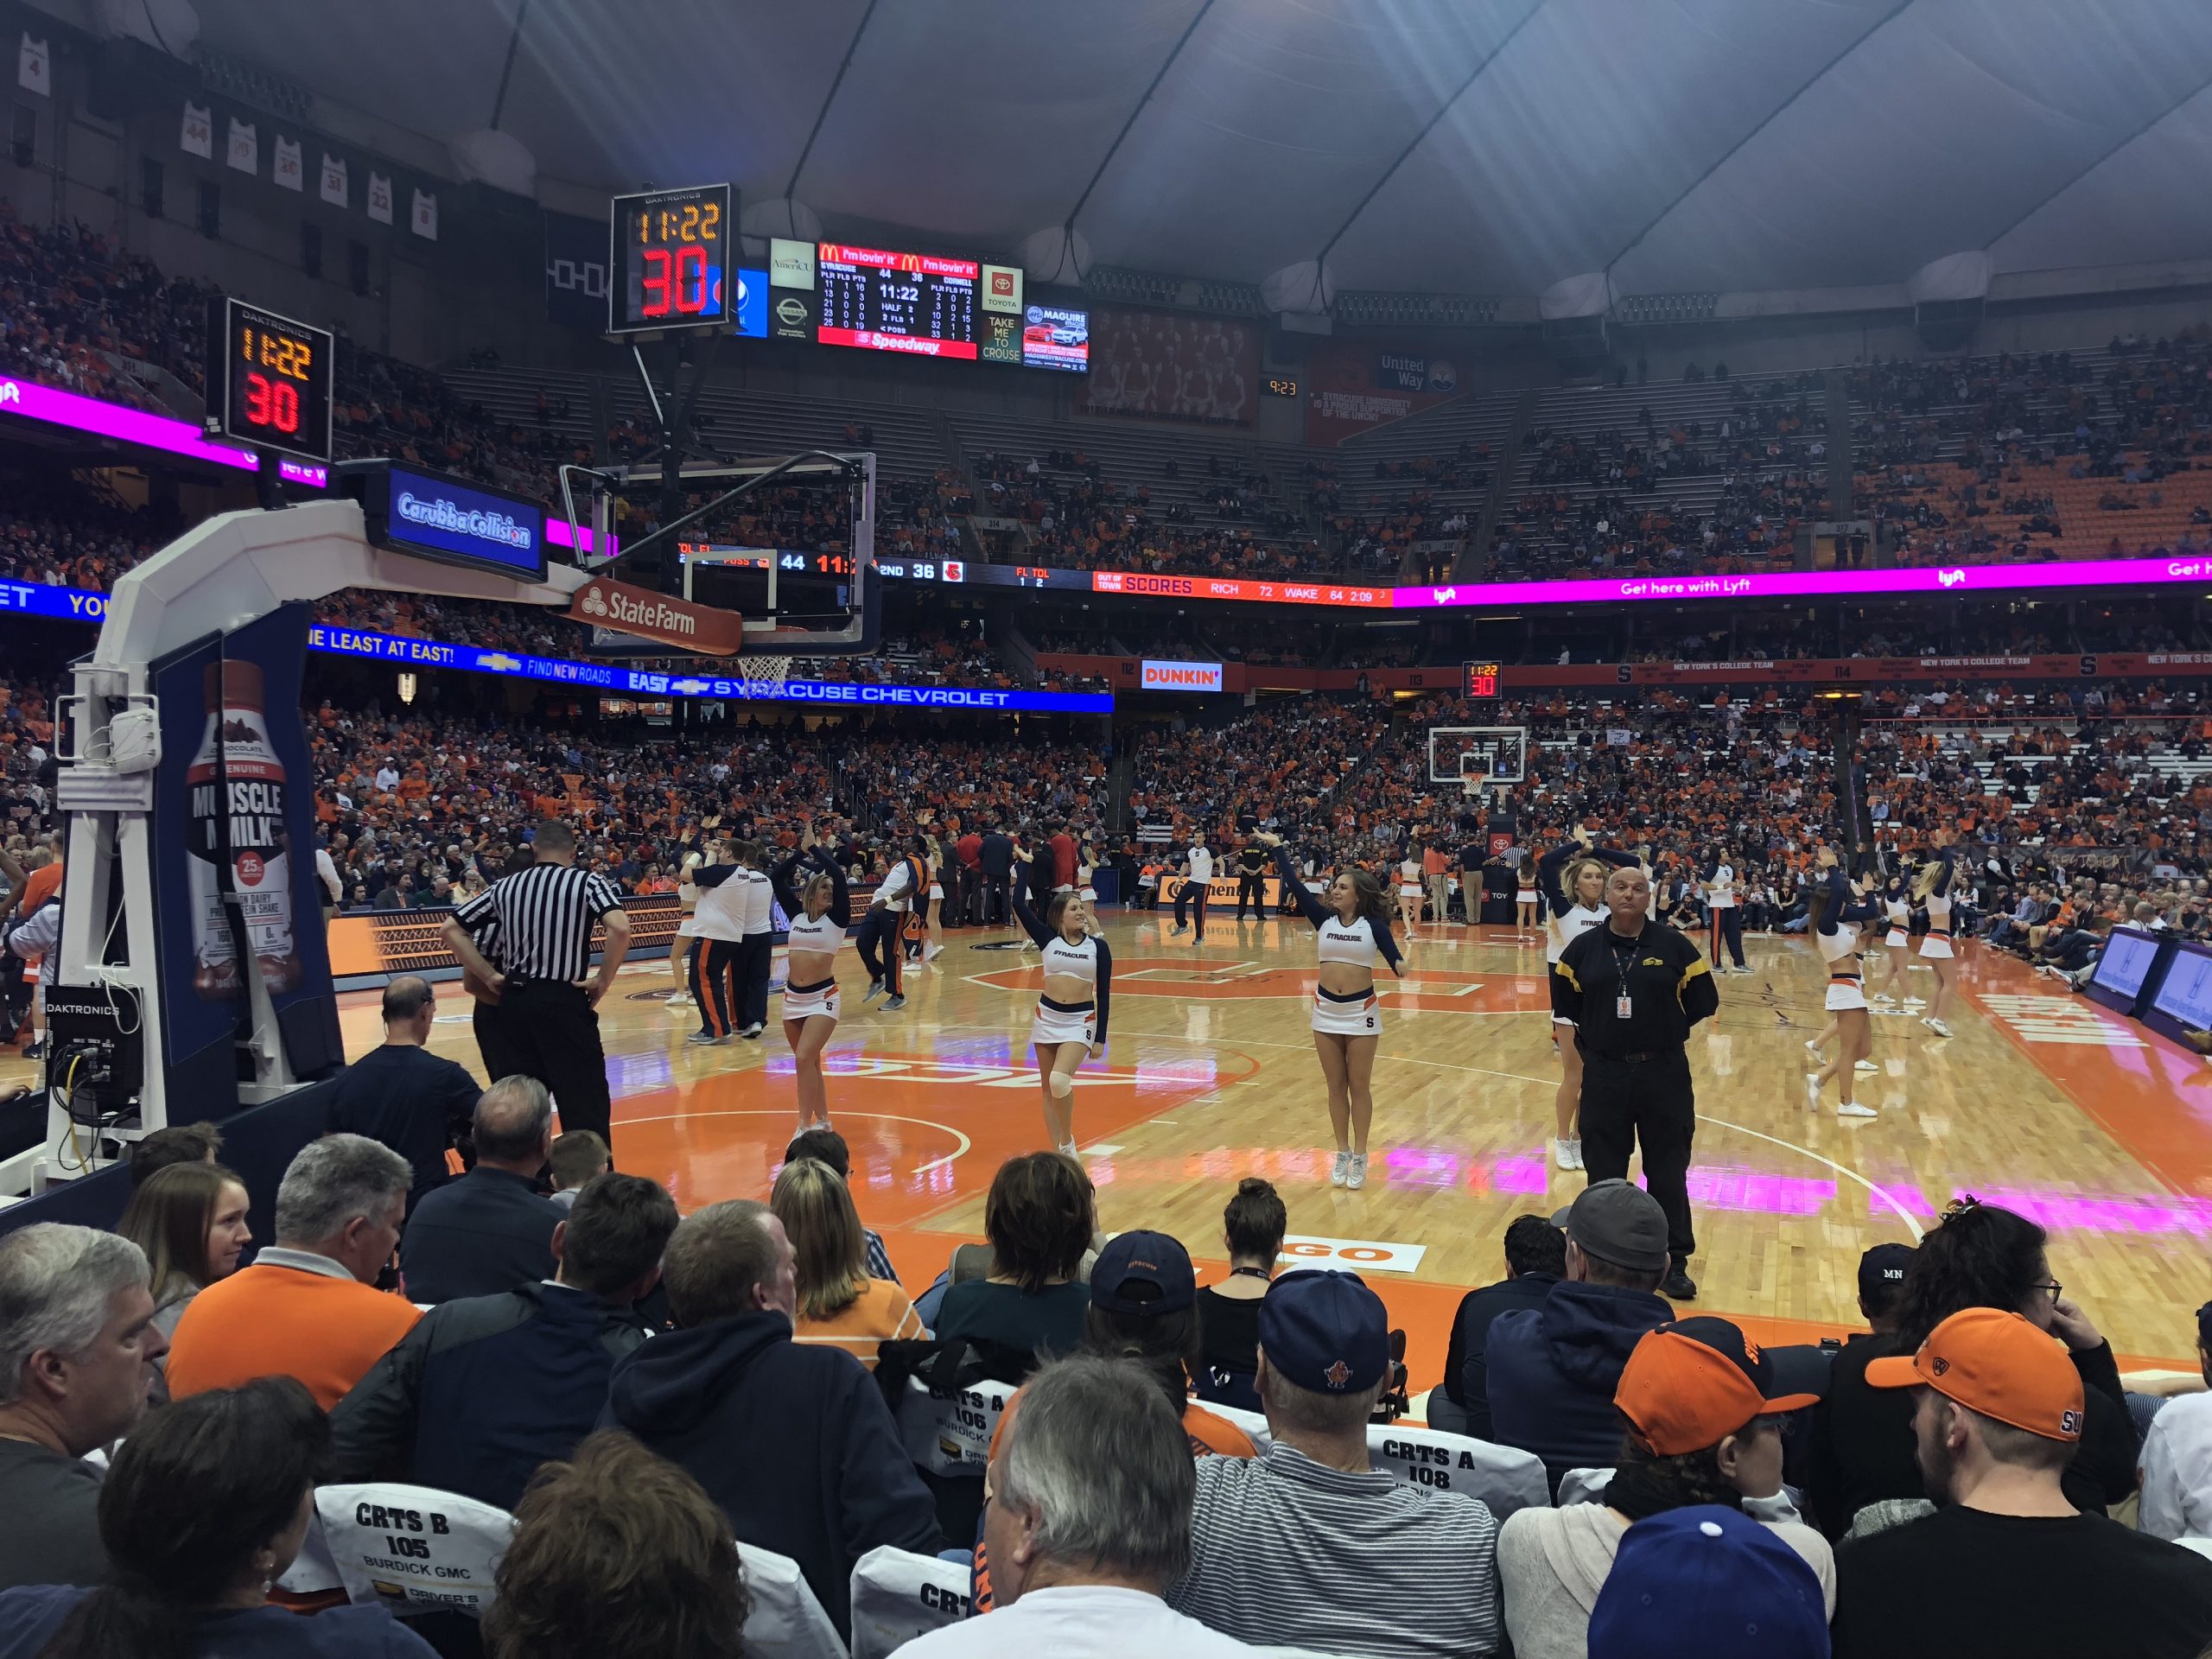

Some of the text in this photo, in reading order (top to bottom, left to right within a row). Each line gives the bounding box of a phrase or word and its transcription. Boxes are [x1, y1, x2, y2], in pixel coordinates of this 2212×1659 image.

[186, 124, 208, 143] 44
[372, 192, 389, 209] 22
[645, 192, 701, 204] DAKTRONICS
[641, 202, 720, 244] 11:22
[773, 258, 813, 272] AmeriCU
[821, 262, 856, 273] SYRACUSE
[642, 245, 708, 316] 30
[879, 269, 923, 283] 44 36
[944, 276, 973, 287] CORNELL
[880, 283, 918, 302] 11:22
[824, 299, 833, 308] 21
[881, 302, 902, 312] HALF
[988, 299, 1016, 308] TOYOTA
[242, 309, 312, 340] DAKTRONICS
[823, 318, 864, 330] 25 19
[963, 315, 971, 323] 15
[989, 316, 1014, 328] TAKE
[1044, 310, 1085, 323] MAGUIRE
[994, 327, 1009, 338] ME
[872, 334, 940, 355] Speedway
[995, 338, 1009, 347] TO
[243, 327, 312, 381] 11:22
[983, 346, 1020, 361] CROUSE
[1382, 355, 1424, 372] United
[1270, 380, 1296, 396] 9:23
[1398, 372, 1424, 391] Way
[246, 372, 299, 433] 30
[1313, 399, 1322, 409] IS
[1331, 401, 1358, 413] PROUD
[1360, 404, 1407, 416] SUPPORTER
[1322, 391, 1412, 410] SYRACUSE UNIVERSITY
[1322, 408, 1334, 417] OF
[1336, 410, 1351, 419] THE
[398, 493, 531, 550] Carubba Collision
[781, 555, 805, 570] 44
[880, 564, 904, 577] 2ND
[912, 563, 935, 579] 36
[1016, 567, 1049, 579] FL TOL
[2168, 562, 2201, 576] Get
[1037, 577, 1044, 588] 2
[1097, 581, 1122, 590] TOWN
[1126, 576, 1192, 594] SCORES
[1938, 569, 1966, 586] lyft
[1211, 582, 1372, 602] RICH 72 WAKE 64 2:09
[1621, 577, 1751, 596] Get here with Lyft
[1433, 588, 1456, 604] lyft
[330, 631, 381, 653] LEAST
[387, 639, 406, 657] AT
[411, 644, 454, 663] EAST!
[1692, 662, 1718, 671] YORK'S
[1920, 658, 1938, 667] NEW
[2008, 657, 2031, 665] TEAM
[2079, 655, 2098, 677] S
[2148, 654, 2168, 664] NEW
[2170, 653, 2202, 664] YORK'S
[527, 659, 612, 684] FIND NEW ROADS
[1121, 663, 1135, 675] 112
[1146, 667, 1219, 685] DUNKIN'
[1471, 665, 1497, 676] 11:22
[1618, 664, 1632, 684] S
[1834, 667, 1851, 679] 114
[1409, 675, 1422, 686] 113
[1471, 676, 1494, 696] 30
[629, 672, 1009, 706] EAST SYRACUSE CHEVROLET
[1325, 933, 1362, 942] SYRACUSE
[1053, 950, 1089, 960] SYRACUSE
[47, 1004, 119, 1015] DAKTRONICS
[826, 1002, 833, 1011] S
[1367, 1017, 1374, 1028] S
[1085, 1030, 1092, 1040] S
[1884, 1268, 1903, 1279] MN
[992, 1395, 1004, 1412] A
[954, 1406, 987, 1430] 106
[2060, 1410, 2082, 1435] SU
[935, 1417, 985, 1443] BURDICK
[1382, 1440, 1476, 1471] CRTS A
[1408, 1465, 1450, 1490] 108
[356, 1502, 449, 1535] CRTS B
[386, 1535, 430, 1559] 105
[363, 1555, 471, 1580] BURDICK GMC
[410, 1588, 479, 1603] DRIVER'S
[920, 1583, 971, 1618] CRT
